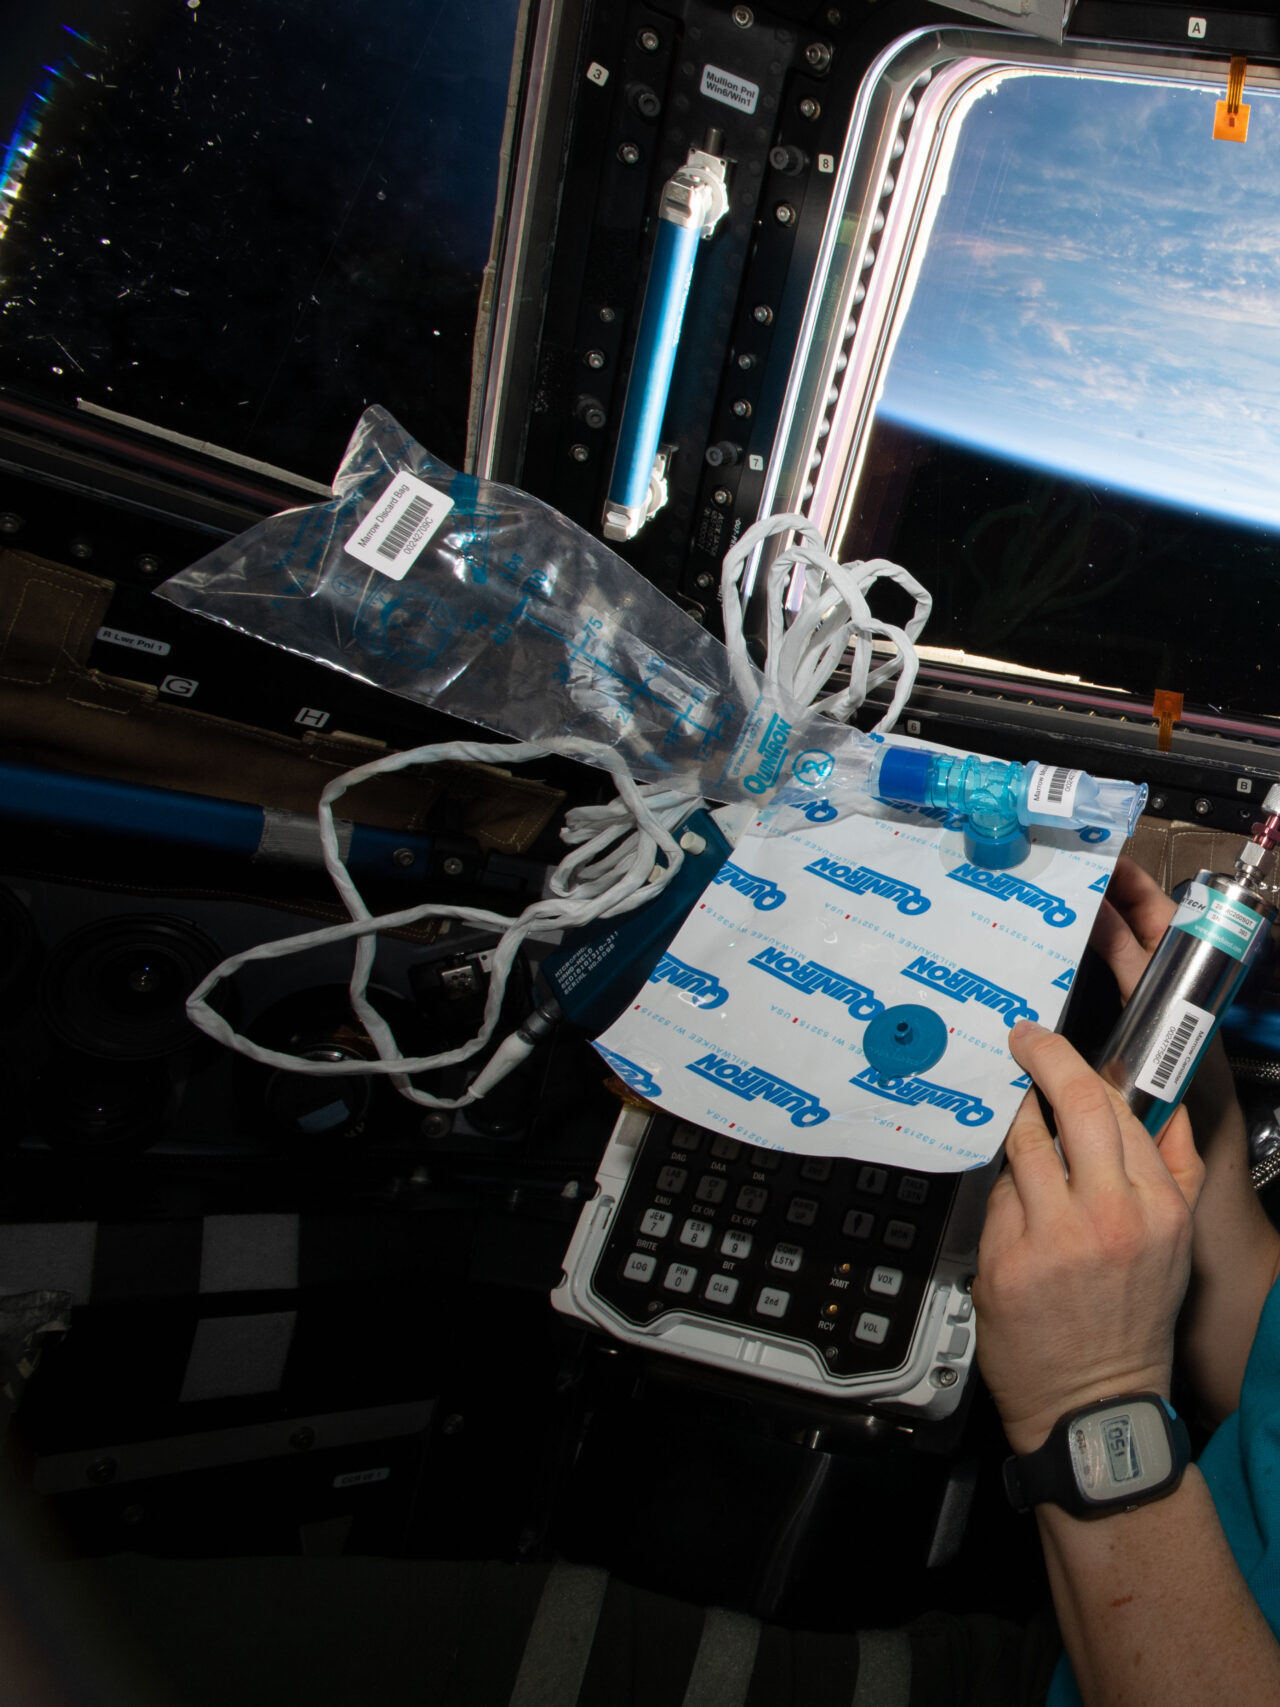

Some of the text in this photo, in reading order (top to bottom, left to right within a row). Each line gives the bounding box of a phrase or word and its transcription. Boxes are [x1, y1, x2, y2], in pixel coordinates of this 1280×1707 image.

[1190, 20, 1203, 36] A
[592, 69, 603, 80] 3
[706, 71, 756, 99] Mullion Pnl
[705, 81, 752, 107] Win6/Win1
[822, 158, 830, 170] 8
[752, 458, 759, 467] 7
[358, 484, 411, 549] Marrow Discard Bag
[499, 553, 525, 580] Lbs
[522, 569, 548, 597] 100
[491, 624, 512, 646] 40
[585, 616, 604, 638] 75
[102, 630, 111, 638] R
[114, 632, 134, 644] Lwr
[137, 637, 154, 650] Pnl
[166, 679, 192, 694] G
[300, 709, 324, 726] H
[615, 702, 635, 723] 20
[911, 722, 917, 732] 6
[694, 745, 712, 763] 12
[1033, 776, 1045, 802] Marrow
[1240, 781, 1248, 790] B
[803, 856, 932, 917] QUINTRON
[945, 862, 1077, 928] QUINTRON
[1180, 898, 1206, 911] TECH
[704, 905, 735, 929] 53215
[823, 902, 957, 969] MILWAUKEE WI 53215 USA
[970, 910, 1044, 950] WI 53215 USA
[750, 927, 807, 961] MILWAUKEE
[747, 945, 885, 1022] QUINTRON
[900, 955, 1040, 1029] QUINTRON
[769, 1004, 846, 1047] WI 53215 USA
[639, 1007, 750, 1068] MILWAUKEE WI 53215
[955, 1029, 1004, 1057] WI 53215
[1174, 1030, 1205, 1085] Marrow Canister
[685, 1053, 831, 1129] QUINTRON
[705, 1108, 728, 1125] USA
[736, 1126, 768, 1144] 53215
[902, 1127, 936, 1146] 53215
[938, 1141, 953, 1153] WI
[654, 1194, 672, 1206] EMU
[650, 1212, 665, 1222] JEM
[691, 1204, 716, 1217] EX ON
[650, 1222, 657, 1231] 7
[730, 1214, 758, 1227] EX OFF
[636, 1238, 659, 1251] BRITE
[691, 1233, 698, 1243] 8
[731, 1243, 738, 1254] 9
[777, 1244, 799, 1256] CONF
[631, 1262, 648, 1272] LOG
[722, 1260, 736, 1271] BIT
[774, 1256, 795, 1267] LSTN
[675, 1266, 689, 1276] PIN
[674, 1276, 682, 1287] 0
[713, 1282, 729, 1293] CLR
[829, 1277, 850, 1289] XMIT
[877, 1274, 894, 1285] VOX
[764, 1295, 779, 1306] 2nd
[817, 1320, 835, 1332] RCV
[863, 1321, 879, 1333] VOL
